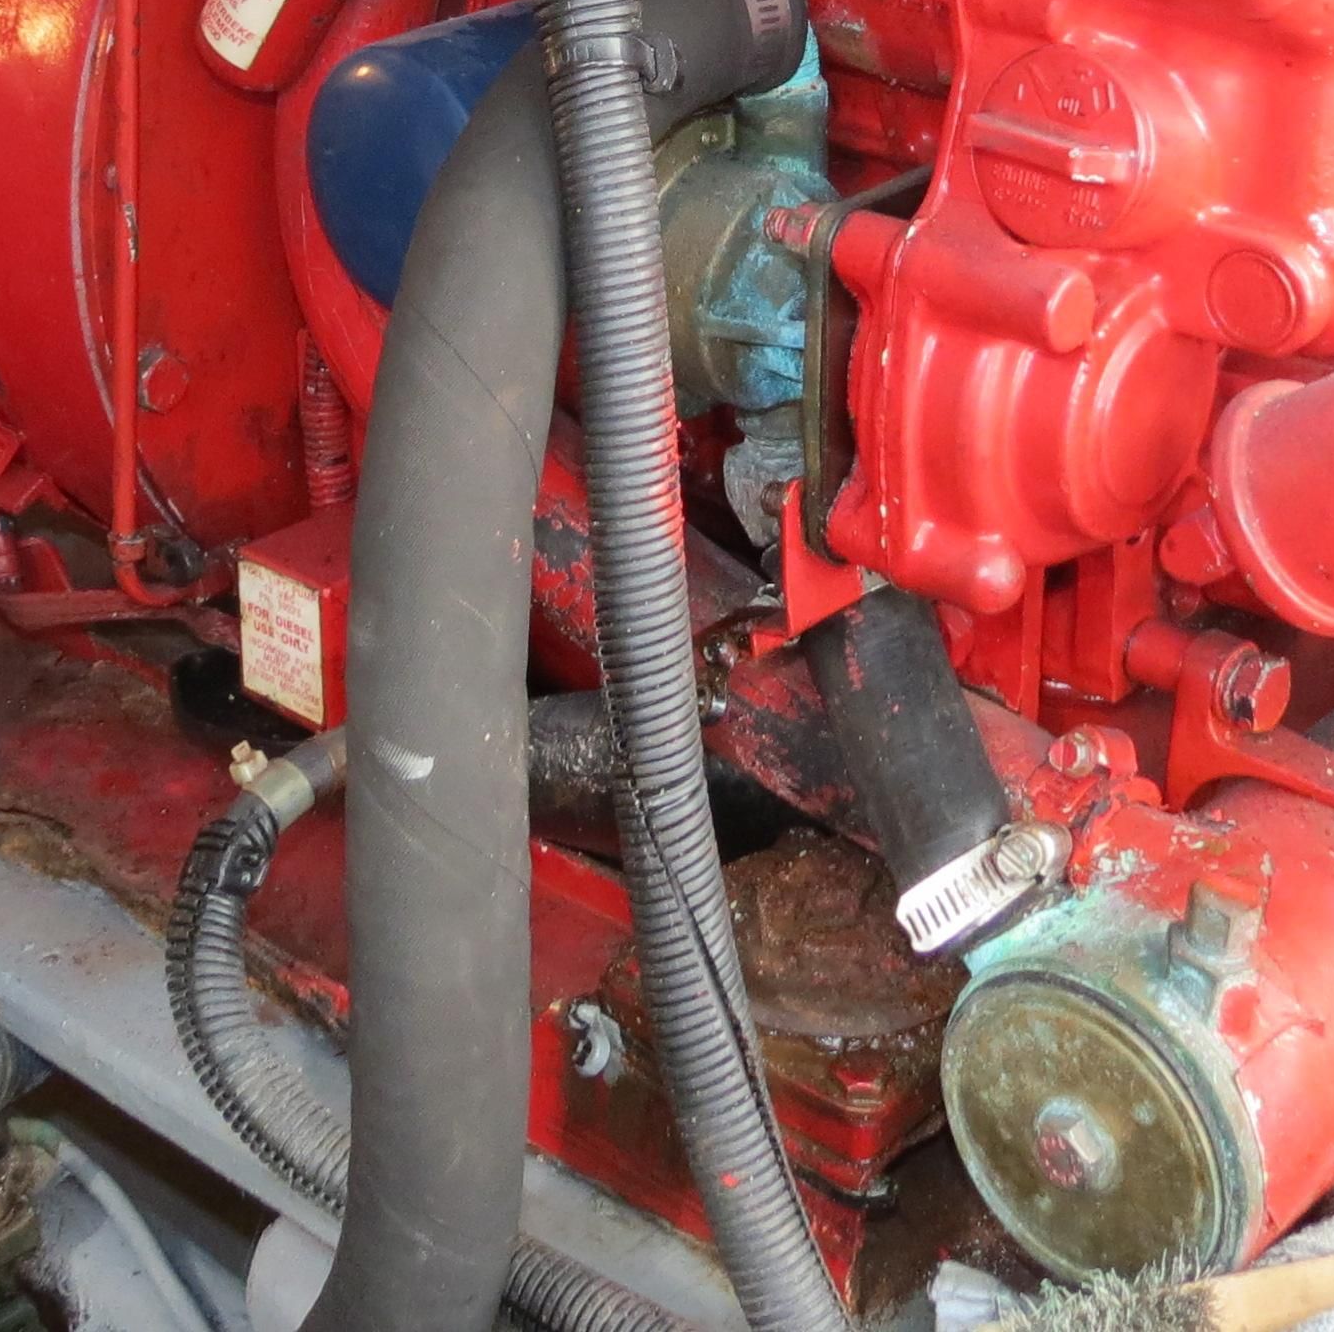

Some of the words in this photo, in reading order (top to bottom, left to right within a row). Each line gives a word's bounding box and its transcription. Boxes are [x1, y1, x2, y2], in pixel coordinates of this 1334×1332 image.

[247, 602, 270, 621] FOR
[275, 615, 315, 642] DIESEL
[253, 621, 275, 639] USE
[280, 633, 310, 654] ONLY
